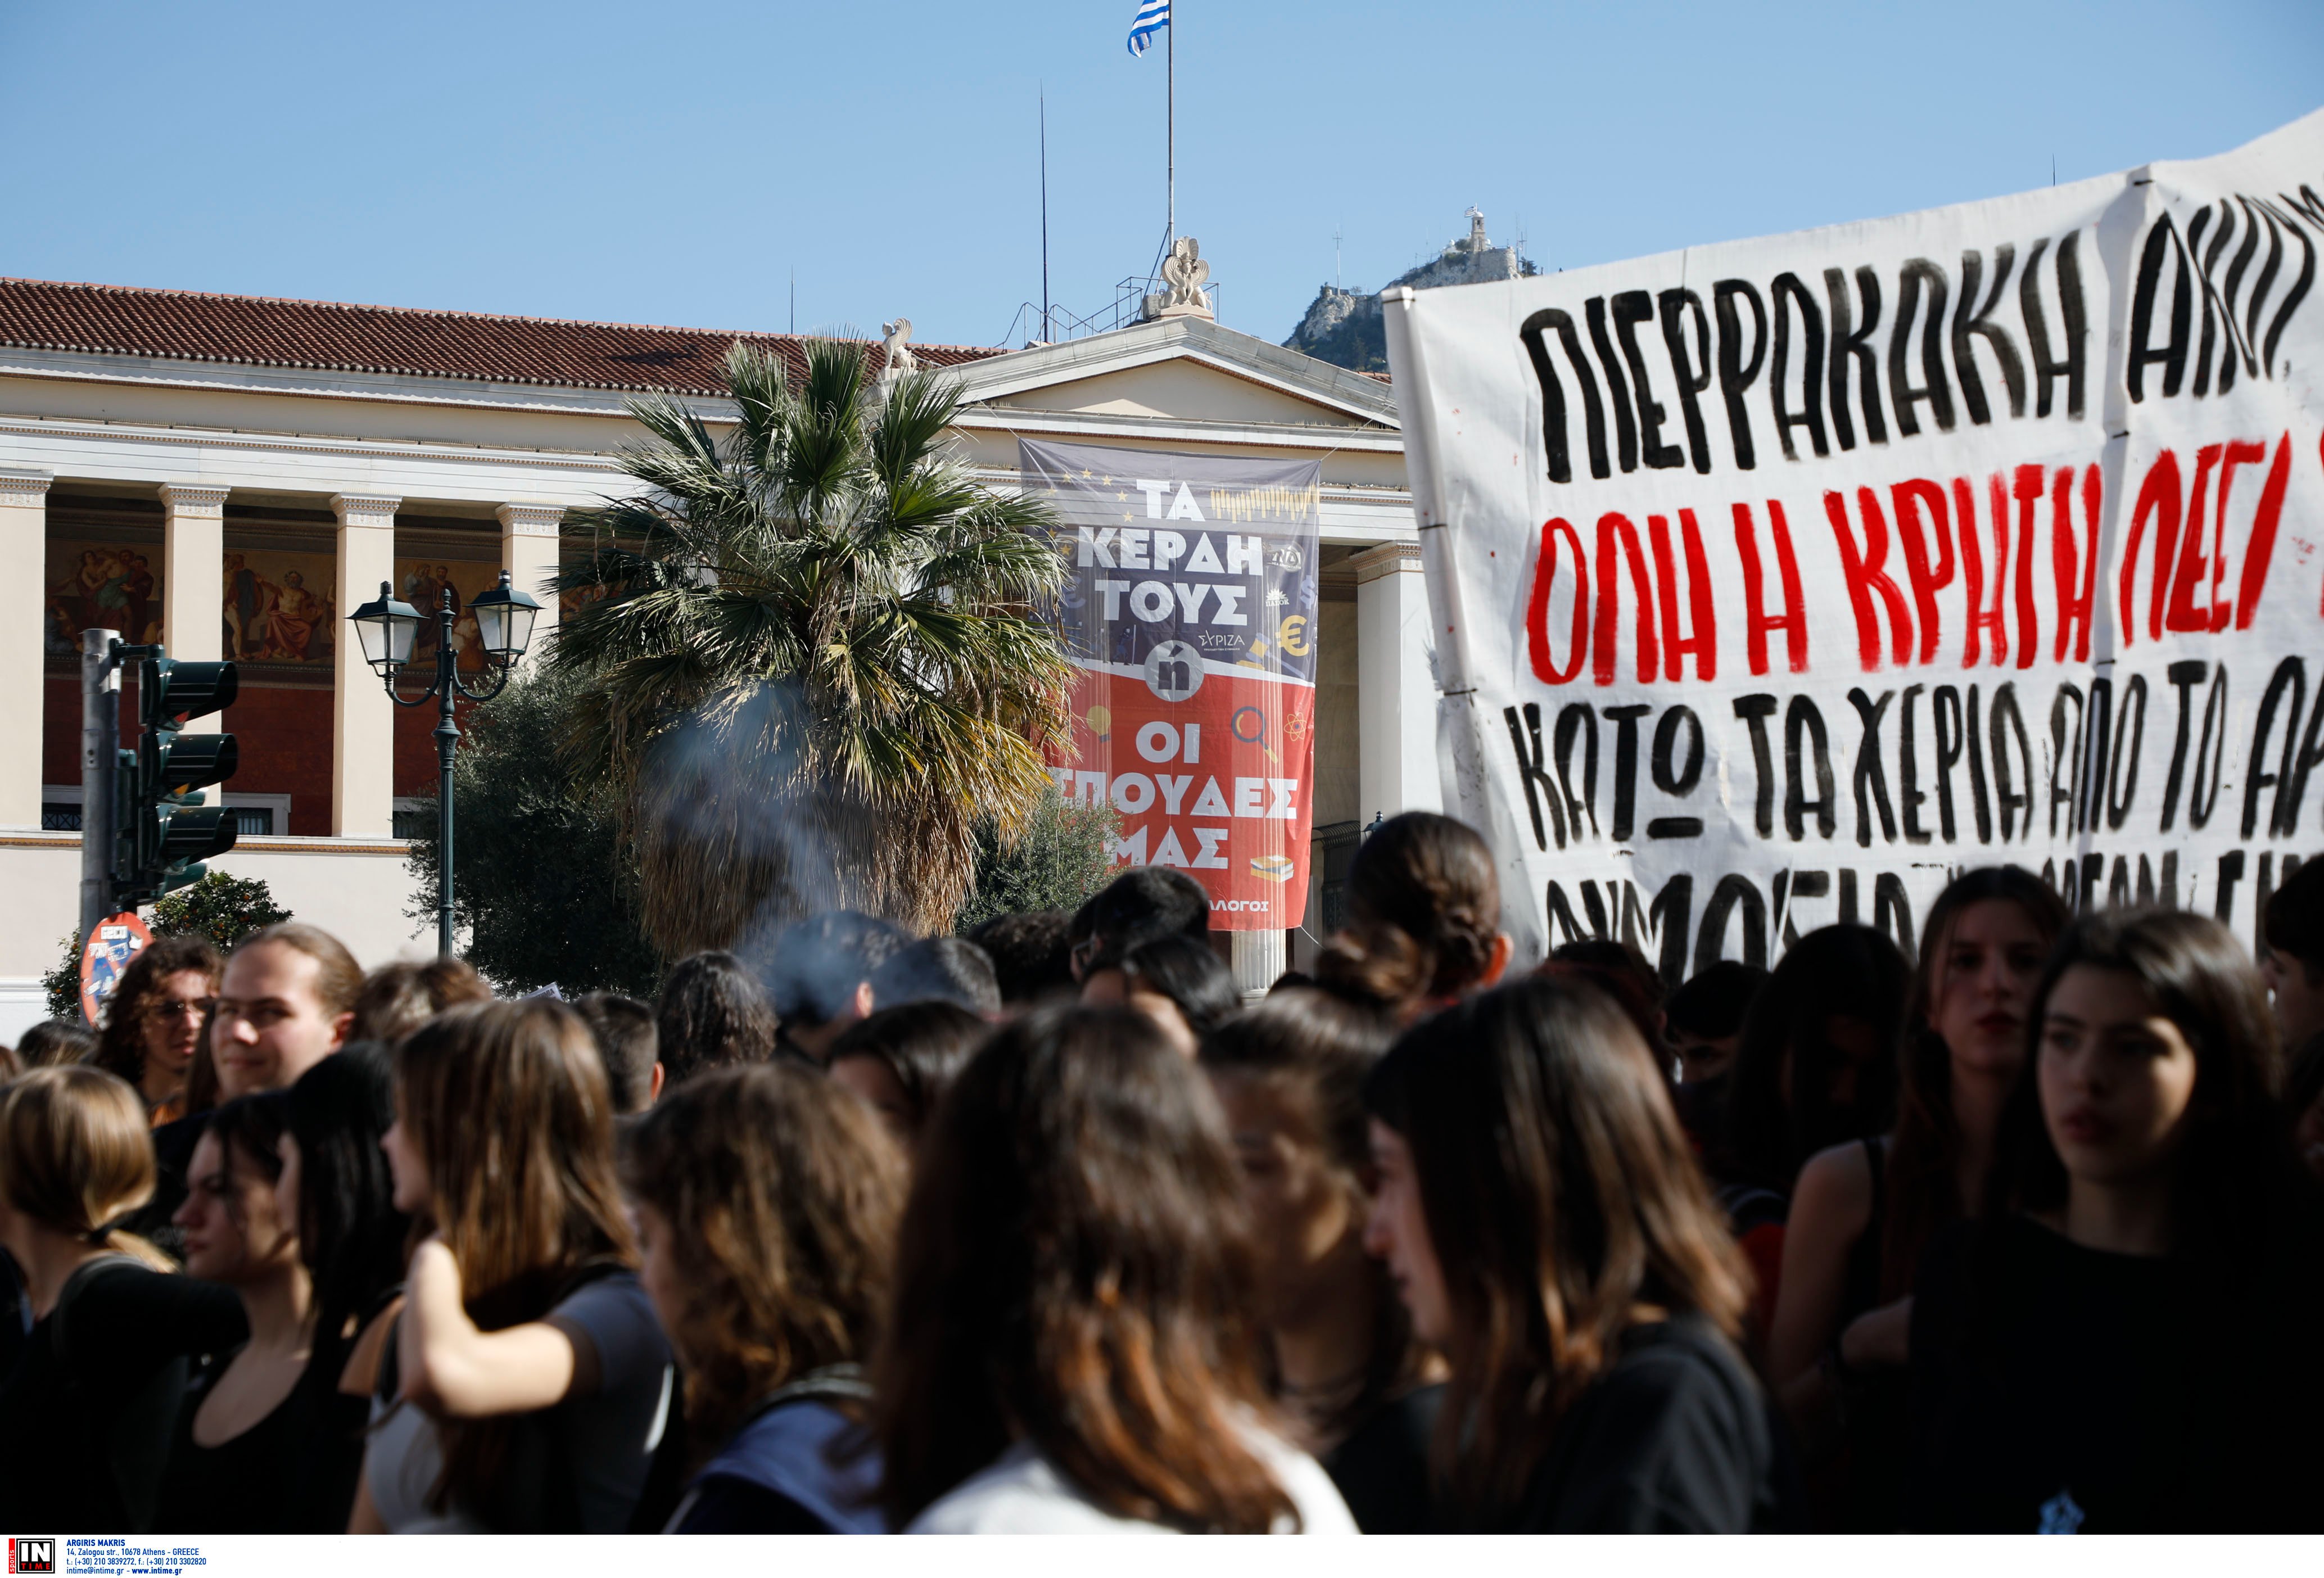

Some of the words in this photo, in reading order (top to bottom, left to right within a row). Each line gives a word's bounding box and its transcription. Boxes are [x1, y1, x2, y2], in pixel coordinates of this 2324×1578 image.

[1520, 229, 2086, 483] ΠΙΕΡΡΑΚΑΚΗ
[1136, 479, 1206, 522] ΤΑ
[1077, 526, 1263, 576] ΚΕΡΔΗ
[1526, 508, 1716, 686] ΟΛΗ
[1732, 499, 1808, 676] Η
[1823, 463, 2101, 673] ΚΡΗΤΗ
[1095, 579, 1248, 626] ΤΟΥΣ
[1198, 630, 1245, 646] ΣΥΡΙΖΑ
[1136, 721, 1200, 764] ΟΙ
[1733, 693, 1835, 842] ΤΑ
[1847, 680, 2034, 848] ΧΕΡΙΑ
[2050, 673, 2147, 843] ΑΠΟ
[2160, 659, 2228, 835] ΤΟ
[1104, 824, 1228, 870] ΜΑΣ
